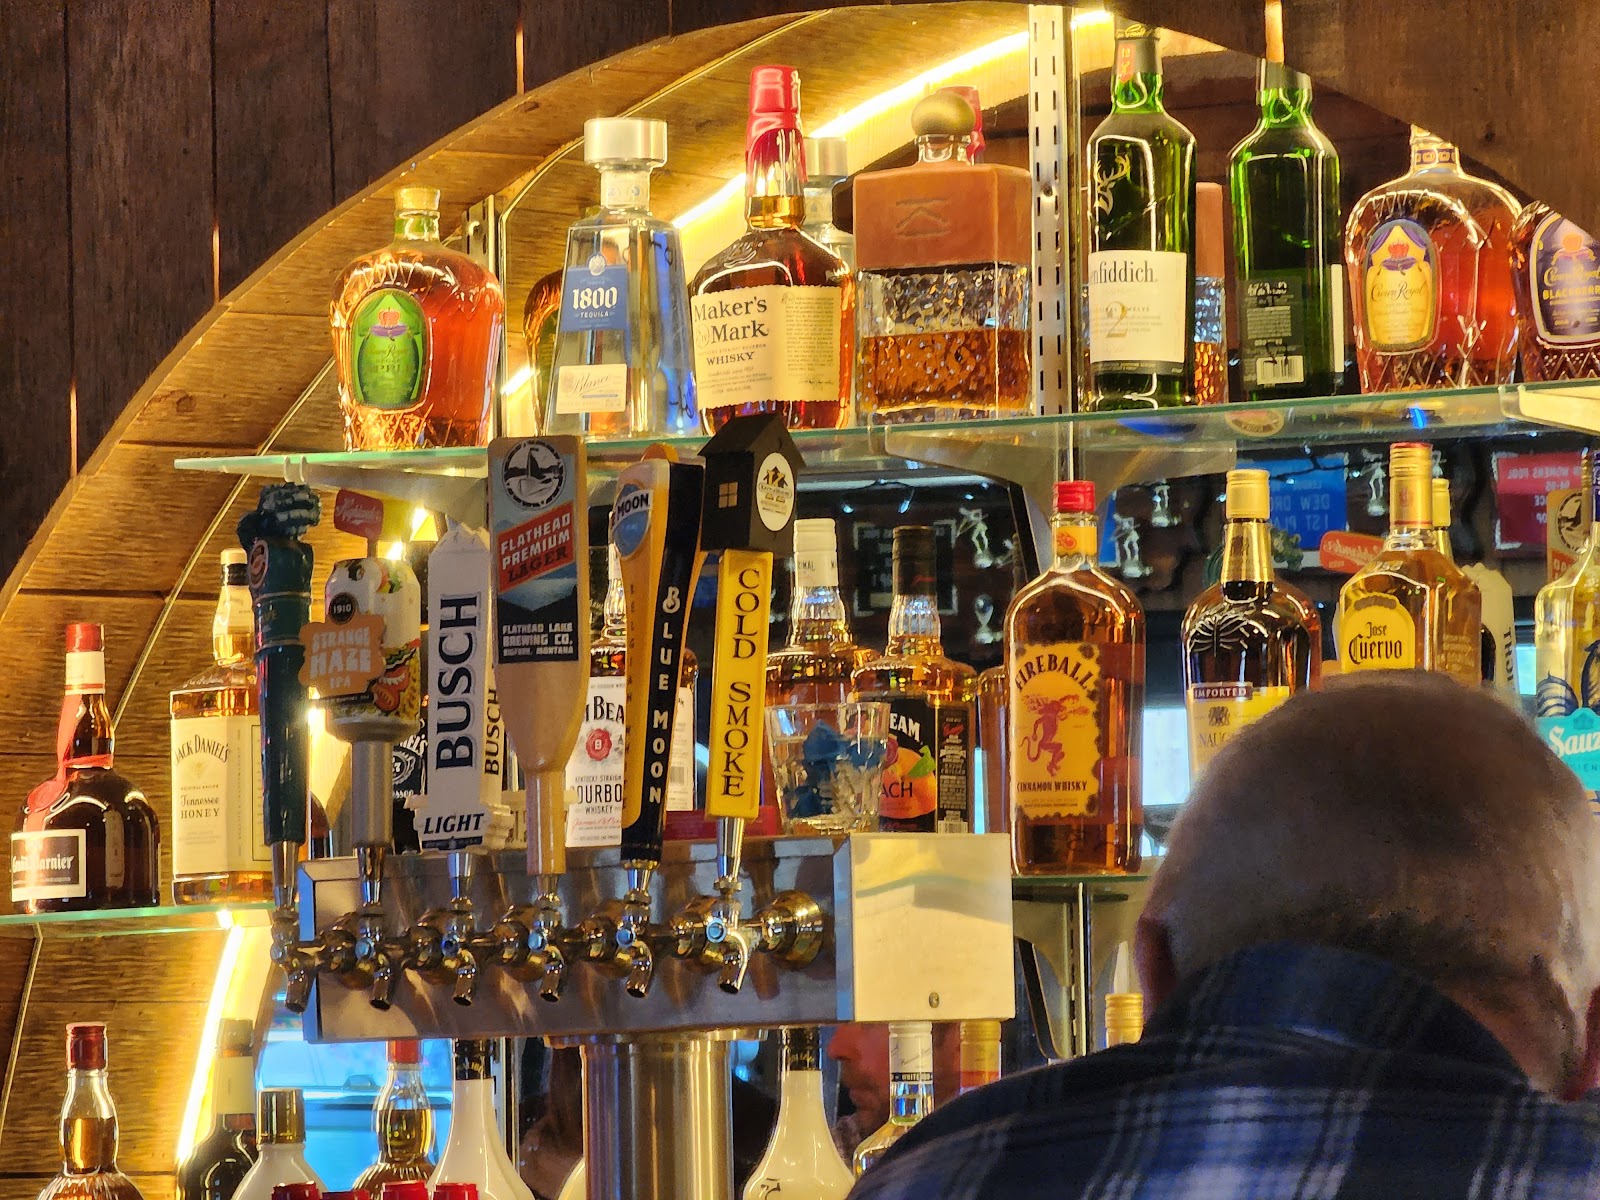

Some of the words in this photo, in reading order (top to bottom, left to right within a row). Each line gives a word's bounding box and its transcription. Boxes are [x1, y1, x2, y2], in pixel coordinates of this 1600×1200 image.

[572, 286, 618, 310] 1800
[1371, 283, 1397, 302] Crown
[1396, 280, 1426, 301] Royal
[580, 310, 609, 318] TEQUILA
[694, 296, 767, 322] Maker's
[711, 320, 768, 344] Mark
[706, 351, 755, 367] WHISKY
[617, 492, 650, 517] MOON
[500, 512, 571, 555] FLATHEAD
[502, 528, 571, 571] PREMIUM
[508, 545, 568, 583] LAGER
[333, 603, 352, 614] 1910
[733, 568, 760, 660] COLD
[312, 626, 370, 653] STRANGE
[502, 623, 544, 635] FLATHEAD
[549, 621, 574, 633] LAKE
[502, 633, 549, 648] BREWING
[554, 632, 574, 646] CO.
[658, 585, 681, 691] BLUE
[536, 645, 574, 655] MONTANA
[1348, 633, 1402, 664] Cuervo
[310, 648, 371, 679] HAZE
[1015, 653, 1094, 691] FIREBALL
[329, 676, 351, 689] IPA
[436, 594, 478, 770] BUSCH
[1194, 687, 1247, 698] IMPORTED
[484, 689, 501, 776] BUSCH
[721, 681, 751, 797] SMOKE
[175, 740, 192, 767] JACK
[194, 734, 230, 763] DANIEL'S
[649, 709, 669, 804] MOON
[571, 783, 623, 804] OURBO
[1017, 781, 1053, 792] CINNAMON
[1054, 780, 1087, 792] WHISKY
[180, 794, 219, 807] Tennessee
[585, 805, 613, 815] WHISKEY
[180, 808, 220, 820] HONEY
[423, 812, 486, 835] LIGHT
[33, 853, 75, 870] arnier
